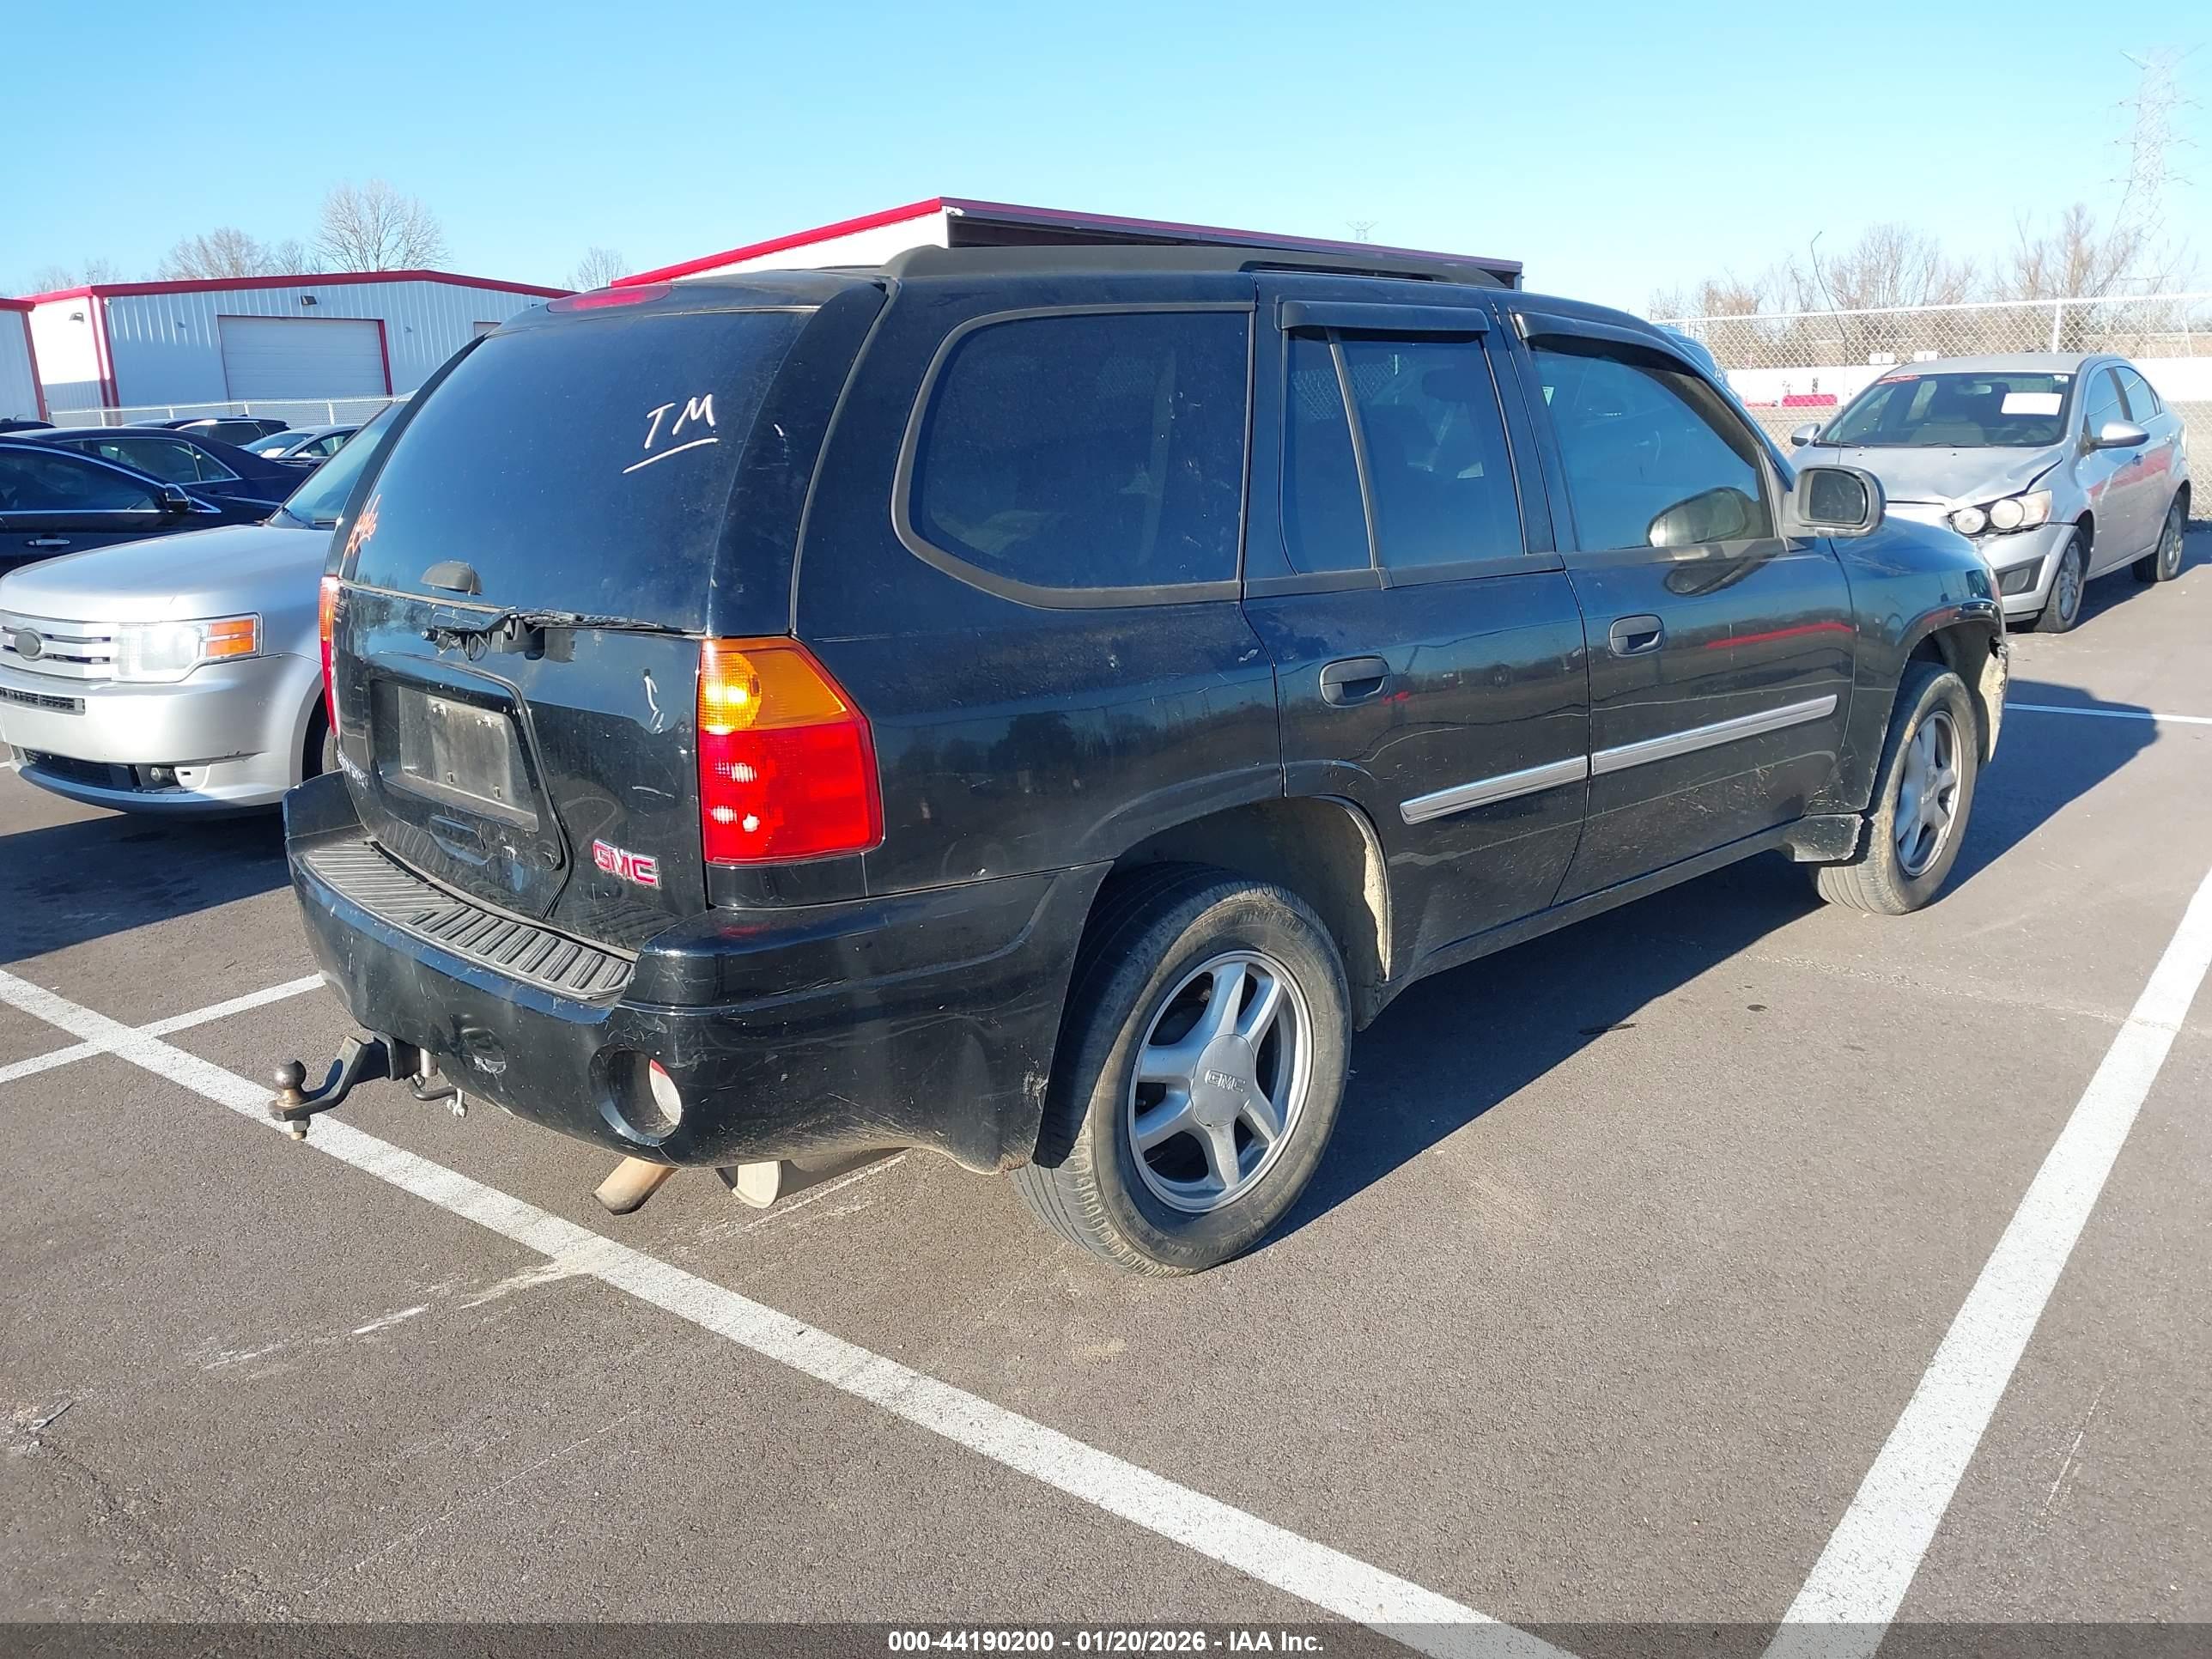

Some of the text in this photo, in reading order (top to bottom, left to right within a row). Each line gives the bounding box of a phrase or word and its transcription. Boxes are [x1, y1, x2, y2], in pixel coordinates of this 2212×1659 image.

[646, 392, 716, 450] TM
[592, 838, 661, 890] GMC
[1204, 1069, 1246, 1093] GMC
